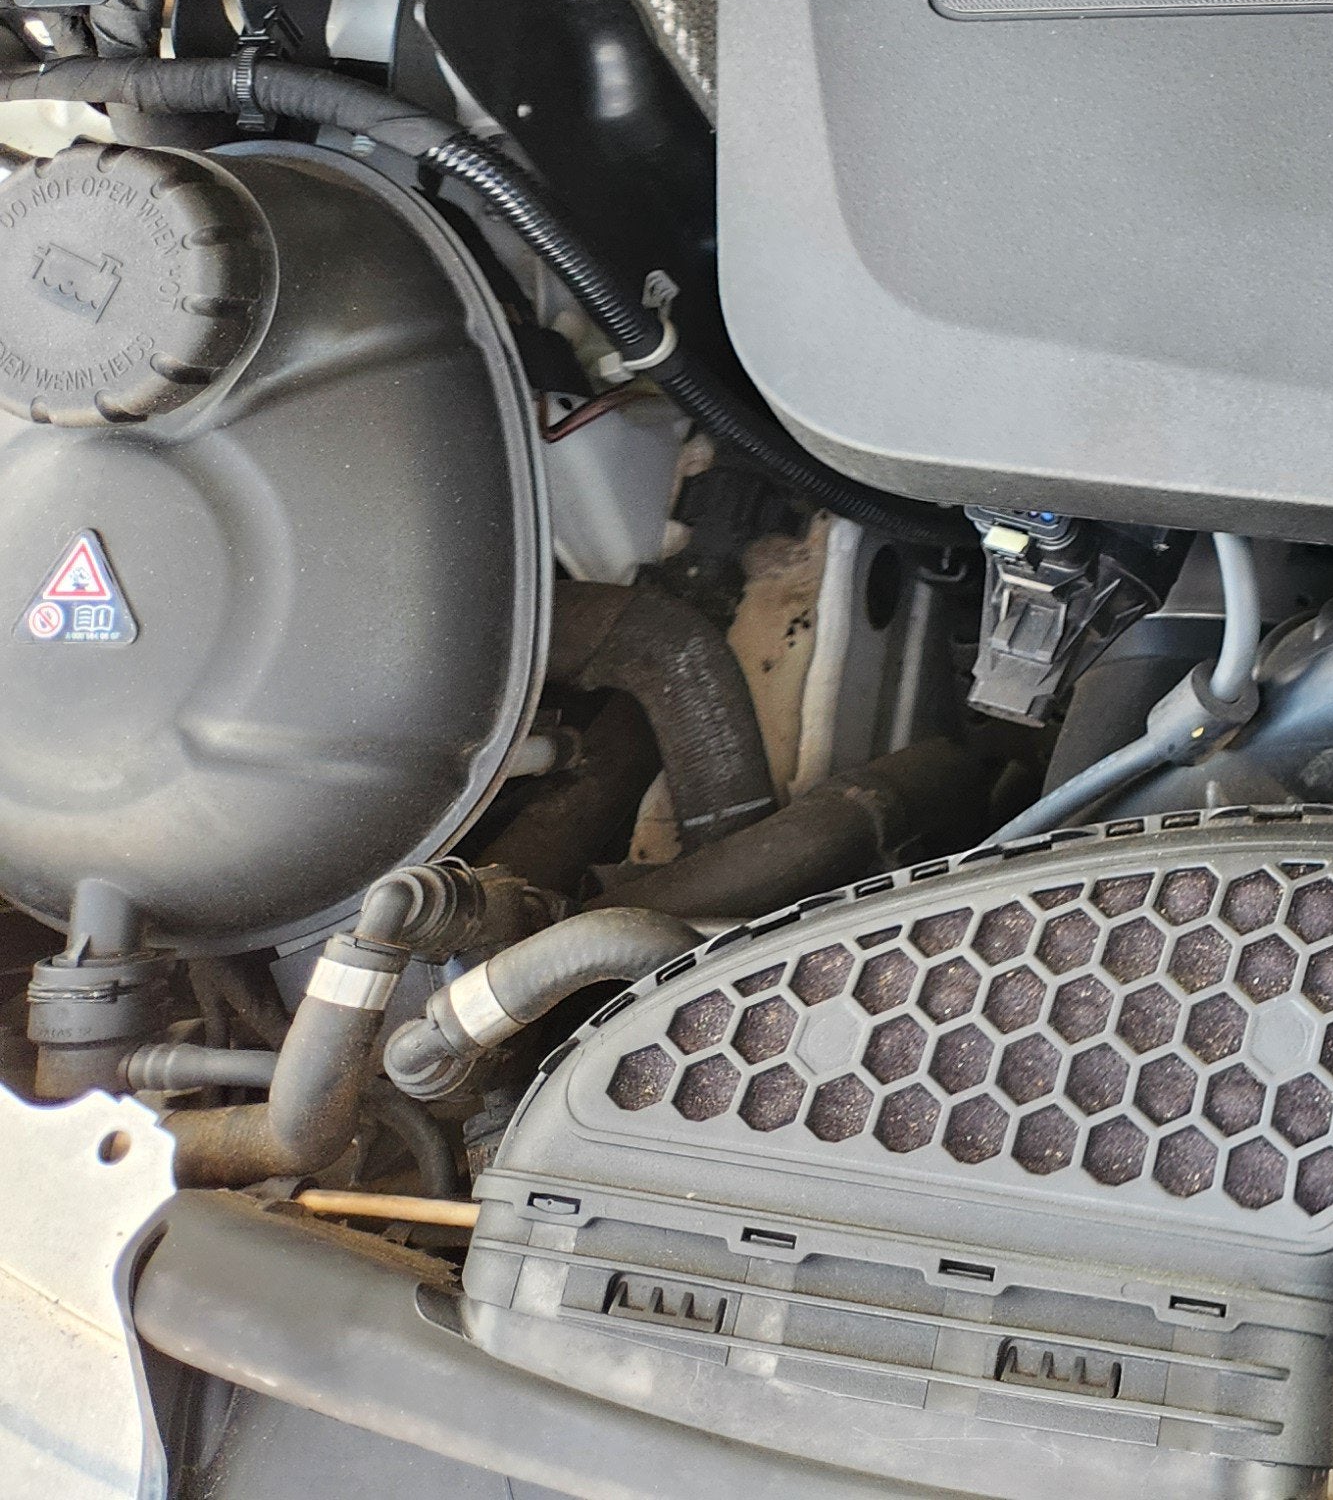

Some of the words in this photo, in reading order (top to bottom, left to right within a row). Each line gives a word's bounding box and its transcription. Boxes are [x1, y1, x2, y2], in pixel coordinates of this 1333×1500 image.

[31, 177, 73, 208] NOT
[81, 175, 139, 209] OPEN
[135, 197, 181, 260] WHEN
[35, 367, 95, 392] WENN
[98, 331, 157, 383] HEISS
